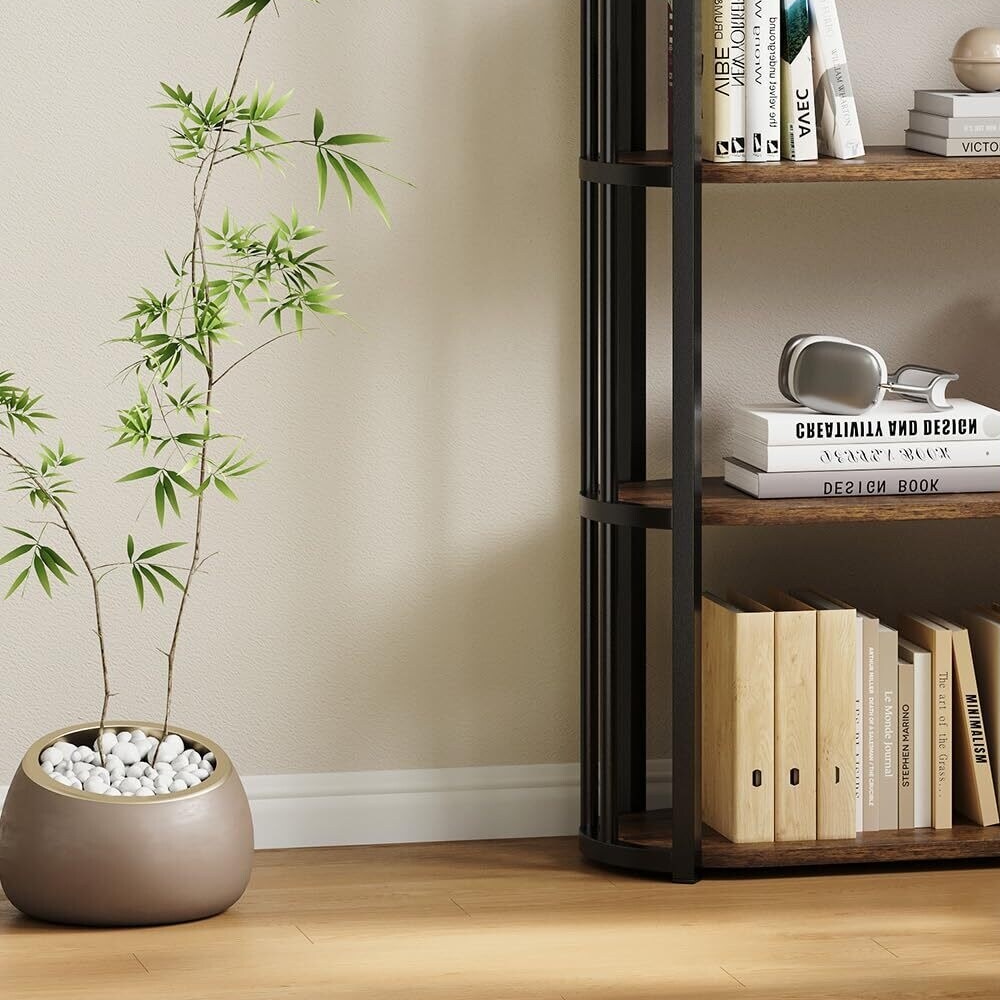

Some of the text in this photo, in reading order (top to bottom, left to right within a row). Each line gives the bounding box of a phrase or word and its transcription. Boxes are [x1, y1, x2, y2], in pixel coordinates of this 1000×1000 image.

[939, 672, 948, 688] The
[883, 690, 894, 777] Le Monde Journal
[938, 732, 946, 749] the
[939, 715, 947, 728] of
[965, 693, 988, 764] MINIMALISM
[901, 704, 910, 787] STEPHEN MARINO
